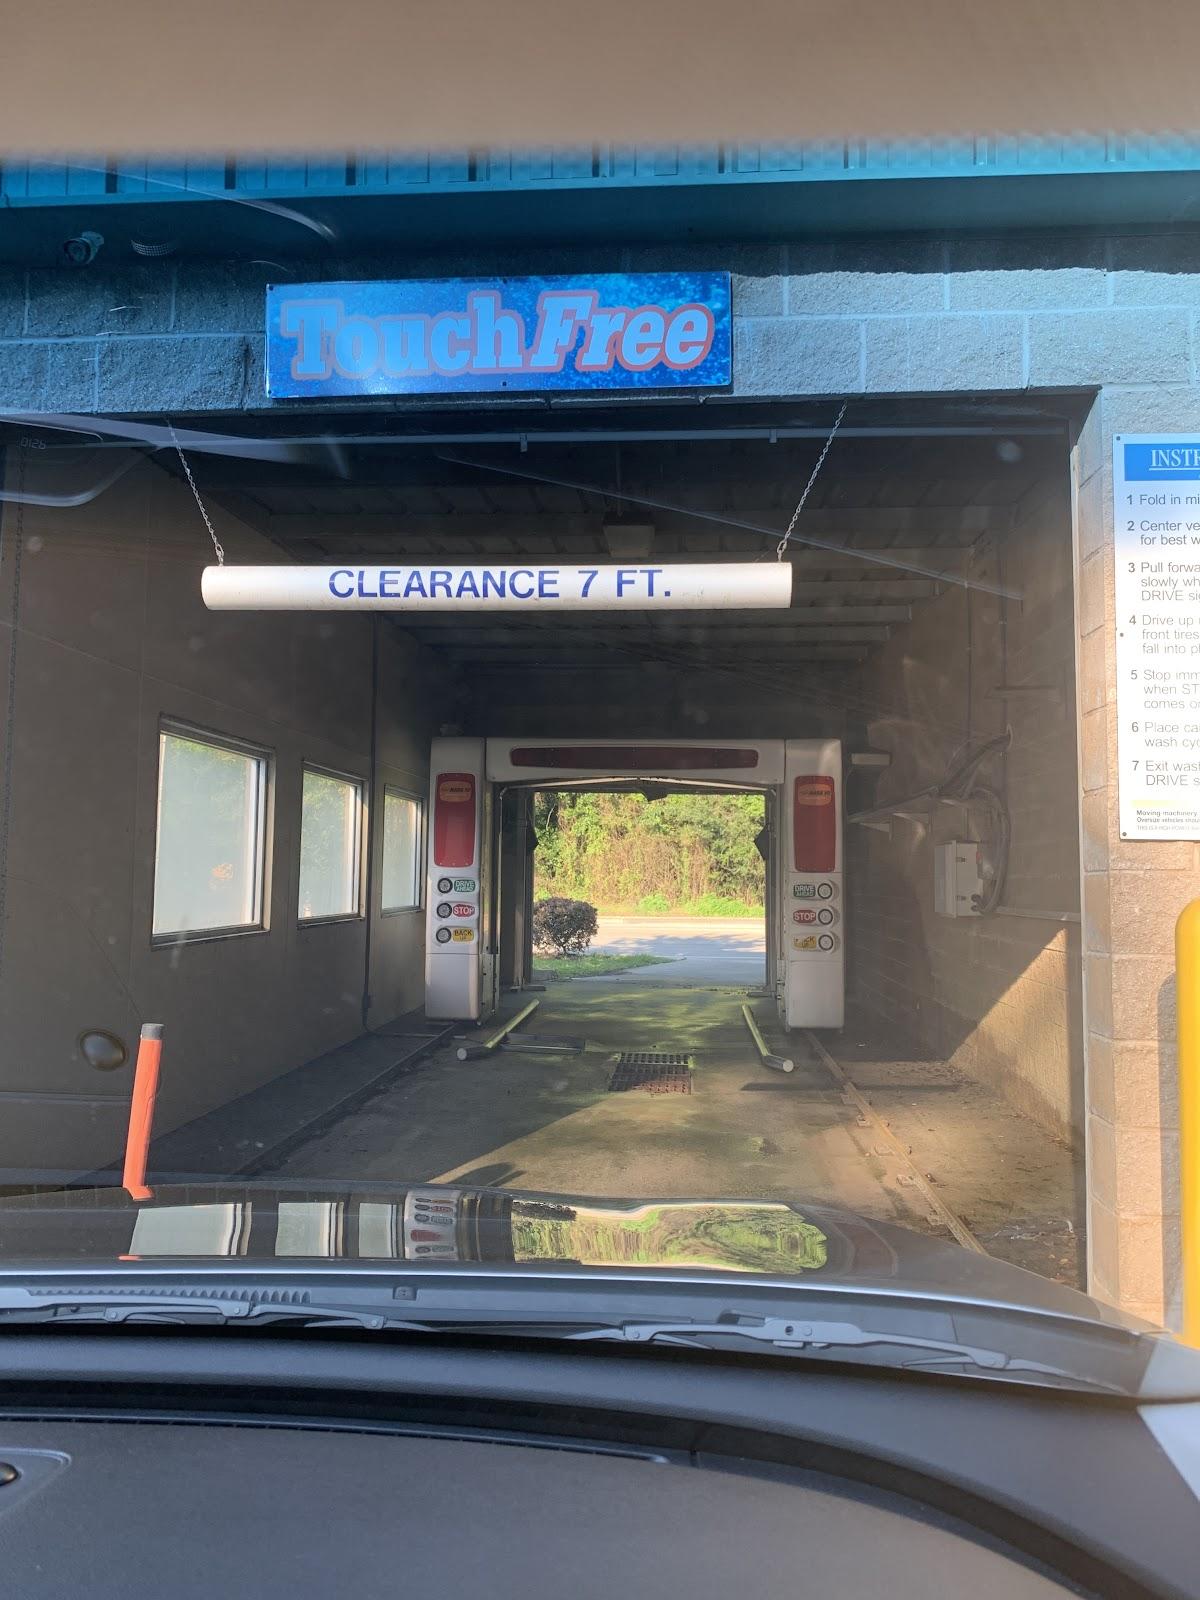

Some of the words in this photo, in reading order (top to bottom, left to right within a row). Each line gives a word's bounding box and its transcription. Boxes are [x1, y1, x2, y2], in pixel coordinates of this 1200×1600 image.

[1127, 494, 1133, 505] 1
[1140, 494, 1166, 505] Fold
[1171, 494, 1181, 504] in
[1127, 521, 1135, 531] 2
[1140, 520, 1182, 531] Center
[1140, 534, 1156, 545] for
[1161, 535, 1187, 545] best
[1128, 562, 1136, 573] 3
[1141, 562, 1163, 573] Pull
[1168, 562, 1200, 573] forwa
[328, 570, 560, 598] CLEARANCE
[578, 570, 599, 597] 7
[616, 569, 671, 597] FT.
[1141, 577, 1178, 589] slowly
[1142, 590, 1184, 601] DRIVE
[1129, 614, 1137, 625] 4
[1142, 615, 1174, 625] Drive
[1179, 617, 1194, 628] up
[1142, 629, 1170, 639] front
[1174, 630, 1200, 639] tires
[1142, 643, 1159, 654] fall
[1165, 644, 1186, 654] into
[1130, 669, 1138, 680] 5
[1143, 669, 1171, 682] Stop
[1144, 684, 1177, 694] when
[1144, 700, 1185, 709] comes
[1132, 722, 1139, 732] 6
[1145, 722, 1179, 732] Place
[1184, 724, 1200, 732] ca
[1145, 737, 1177, 747] wash
[1132, 760, 1139, 771] 7
[1146, 760, 1169, 771] Exit
[1146, 775, 1188, 786] DRIVE
[453, 906, 474, 915] STOP
[794, 912, 815, 920] STOP
